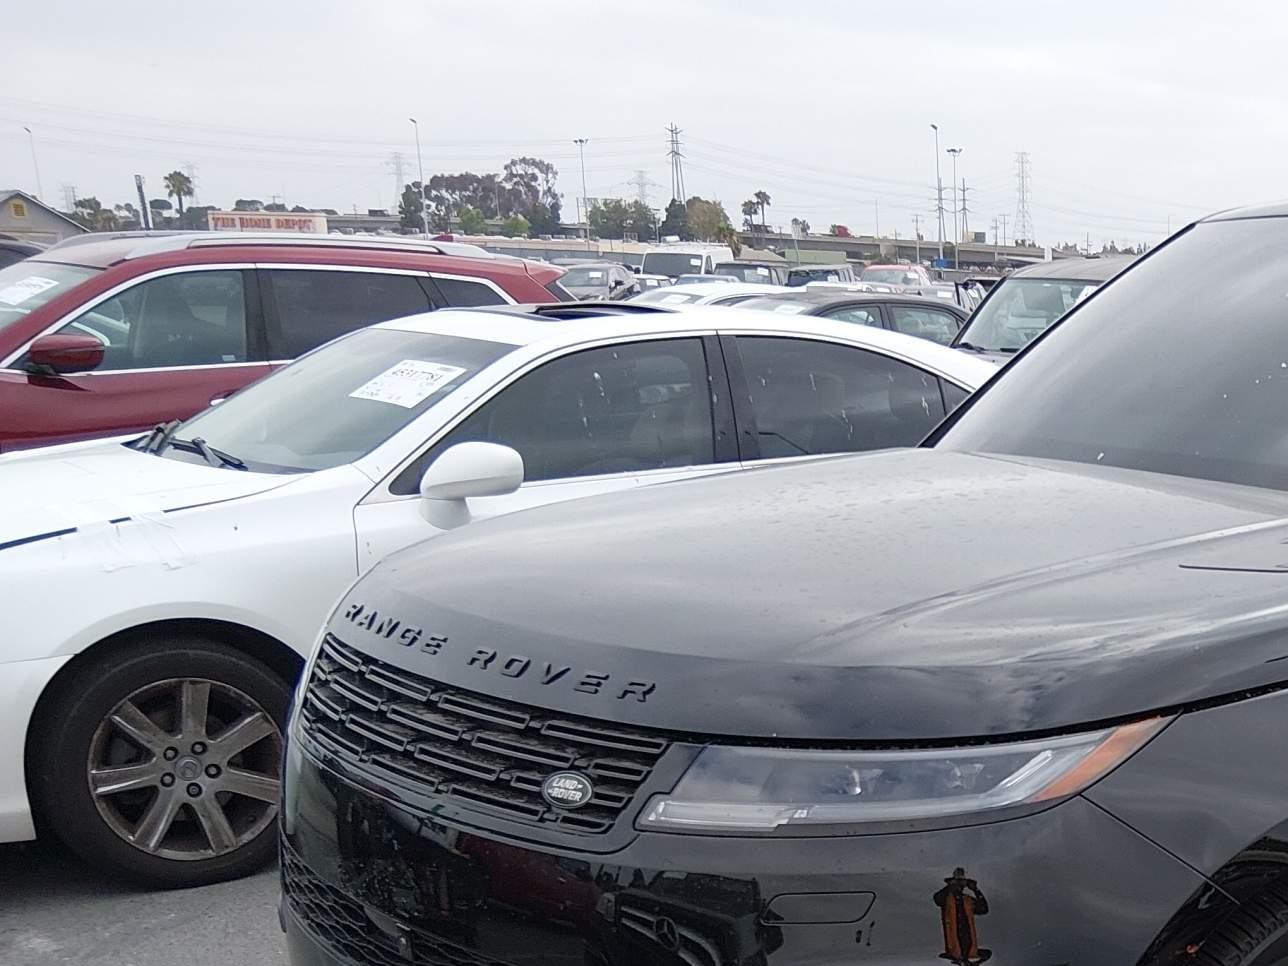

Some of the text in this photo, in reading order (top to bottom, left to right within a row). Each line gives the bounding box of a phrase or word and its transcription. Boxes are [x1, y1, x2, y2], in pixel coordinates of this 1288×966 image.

[212, 217, 236, 228] THE
[276, 218, 313, 230] DEPOT
[345, 604, 656, 703] RANGE ROVER
[552, 778, 578, 790] LAND
[551, 787, 583, 802] ROVER
